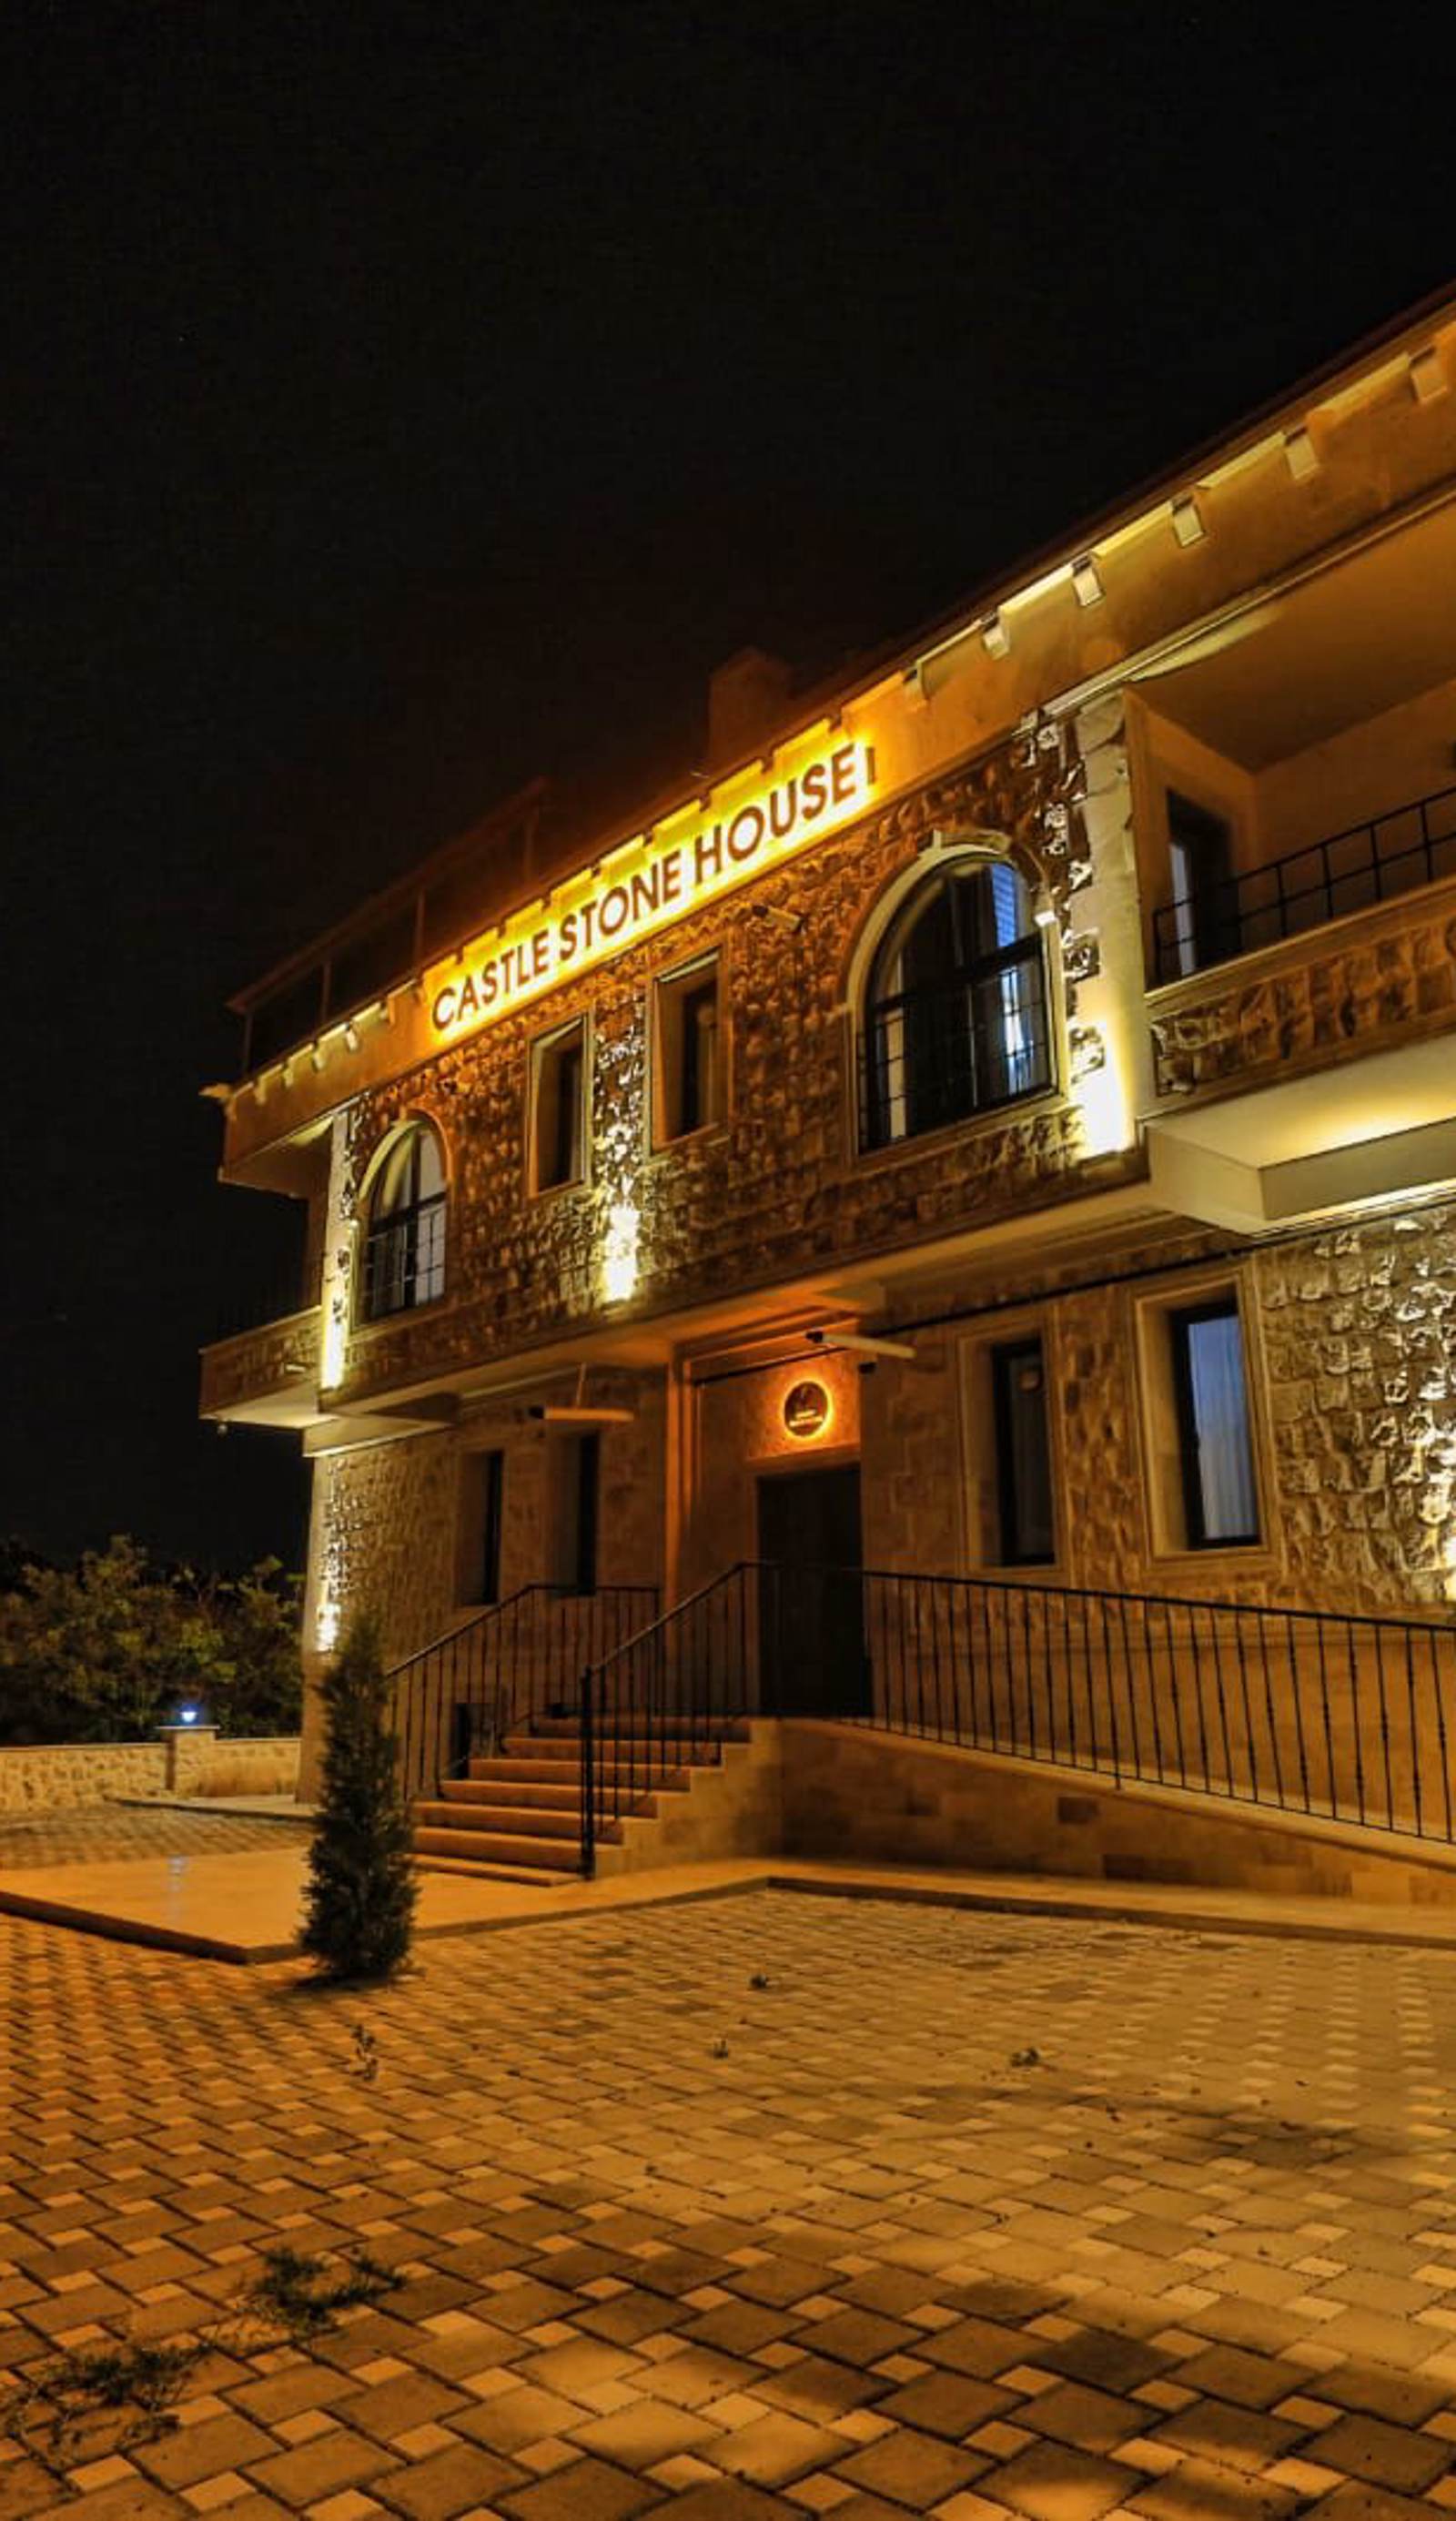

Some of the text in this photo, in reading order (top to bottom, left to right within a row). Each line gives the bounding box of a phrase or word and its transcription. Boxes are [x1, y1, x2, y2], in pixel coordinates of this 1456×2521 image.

[432, 928, 549, 1030] CASTLE
[559, 850, 682, 961] STONE
[694, 744, 856, 885] HOUSE
